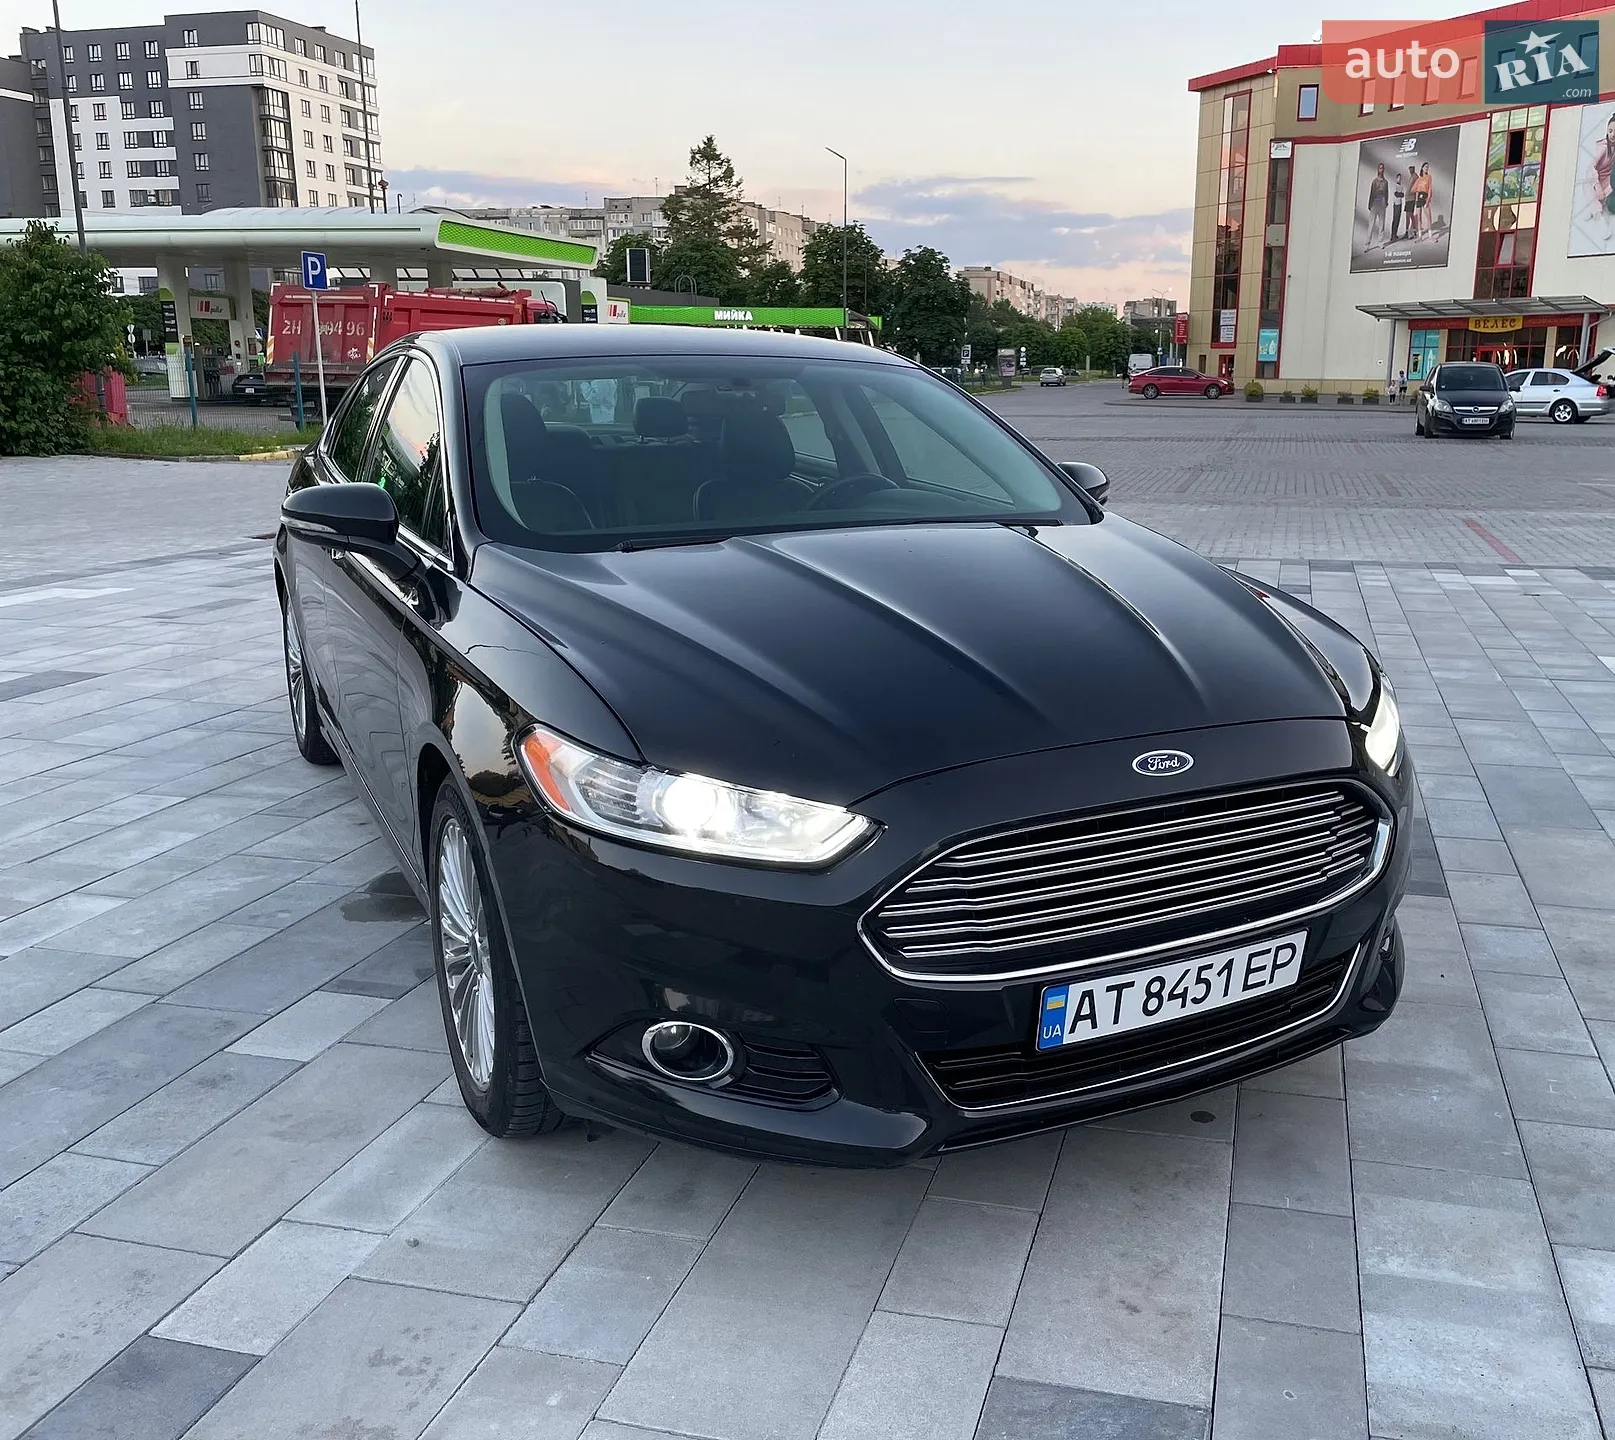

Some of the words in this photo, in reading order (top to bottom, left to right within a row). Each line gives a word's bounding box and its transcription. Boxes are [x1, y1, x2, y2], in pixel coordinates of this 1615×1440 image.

[307, 256, 321, 285] P
[714, 309, 753, 321] МИЙКА
[1474, 317, 1517, 329] ВЕЛЕС
[1148, 755, 1180, 771] Ford
[1043, 1026, 1062, 1039] UA
[1068, 981, 1135, 1035] AT
[1141, 957, 1235, 1017] 8451
[1242, 942, 1297, 992] EP
